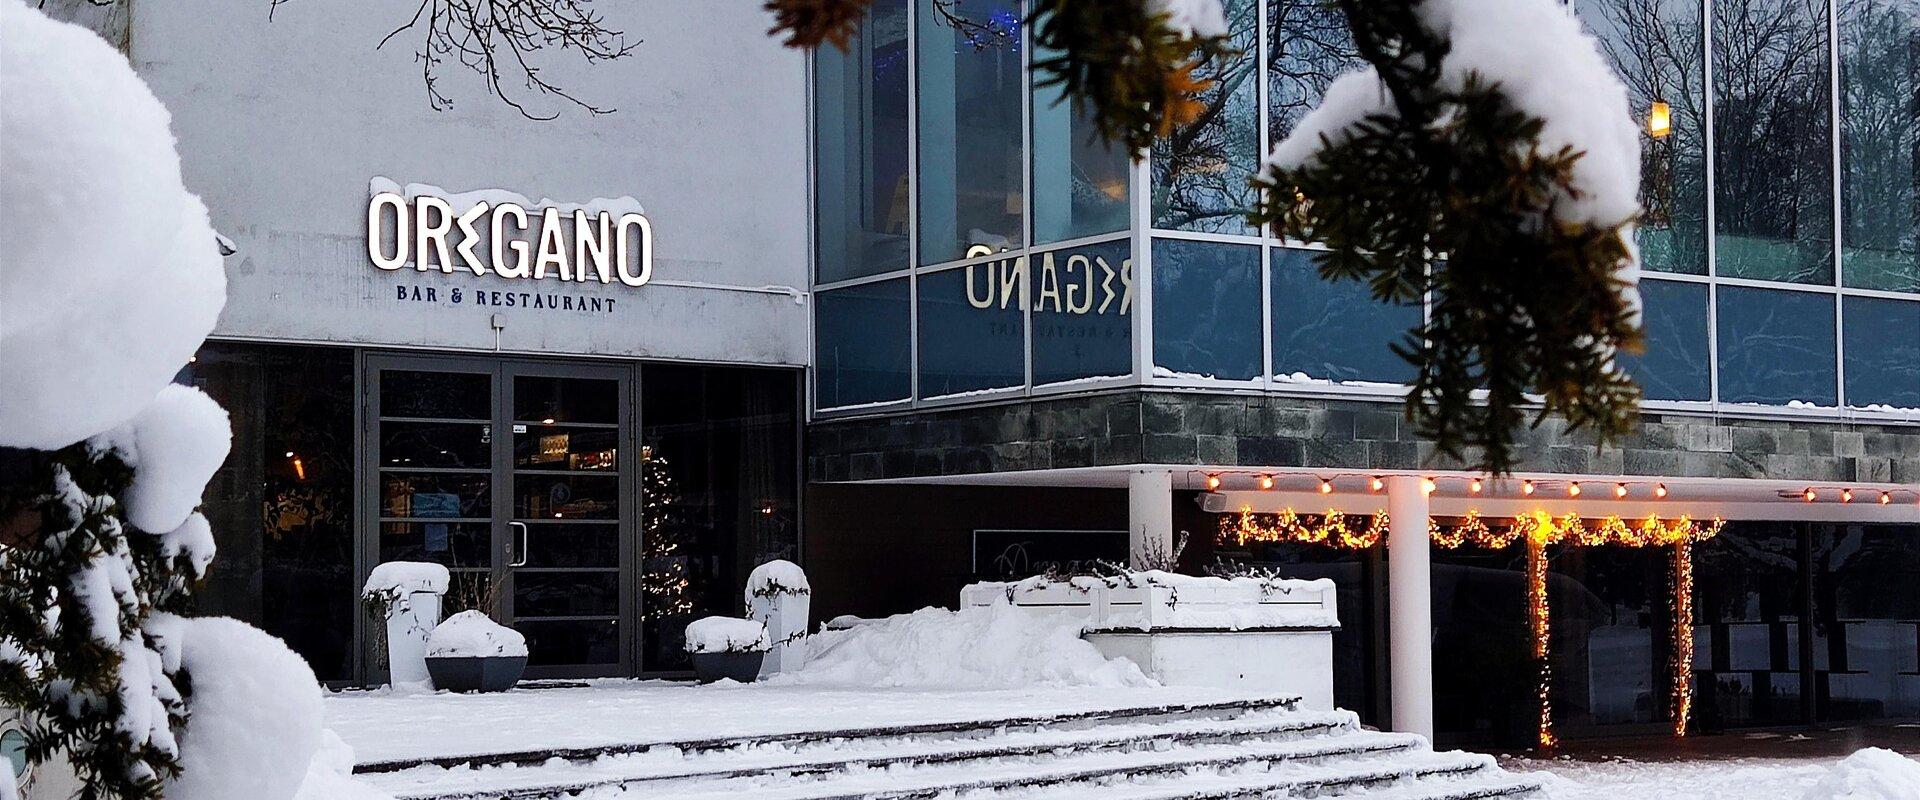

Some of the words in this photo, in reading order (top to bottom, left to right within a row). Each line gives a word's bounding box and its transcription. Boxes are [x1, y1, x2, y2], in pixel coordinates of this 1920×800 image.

[368, 191, 653, 287] OREGANO
[396, 285, 437, 303] BAR
[451, 287, 462, 304] &
[476, 290, 616, 313] RESTAURANT
